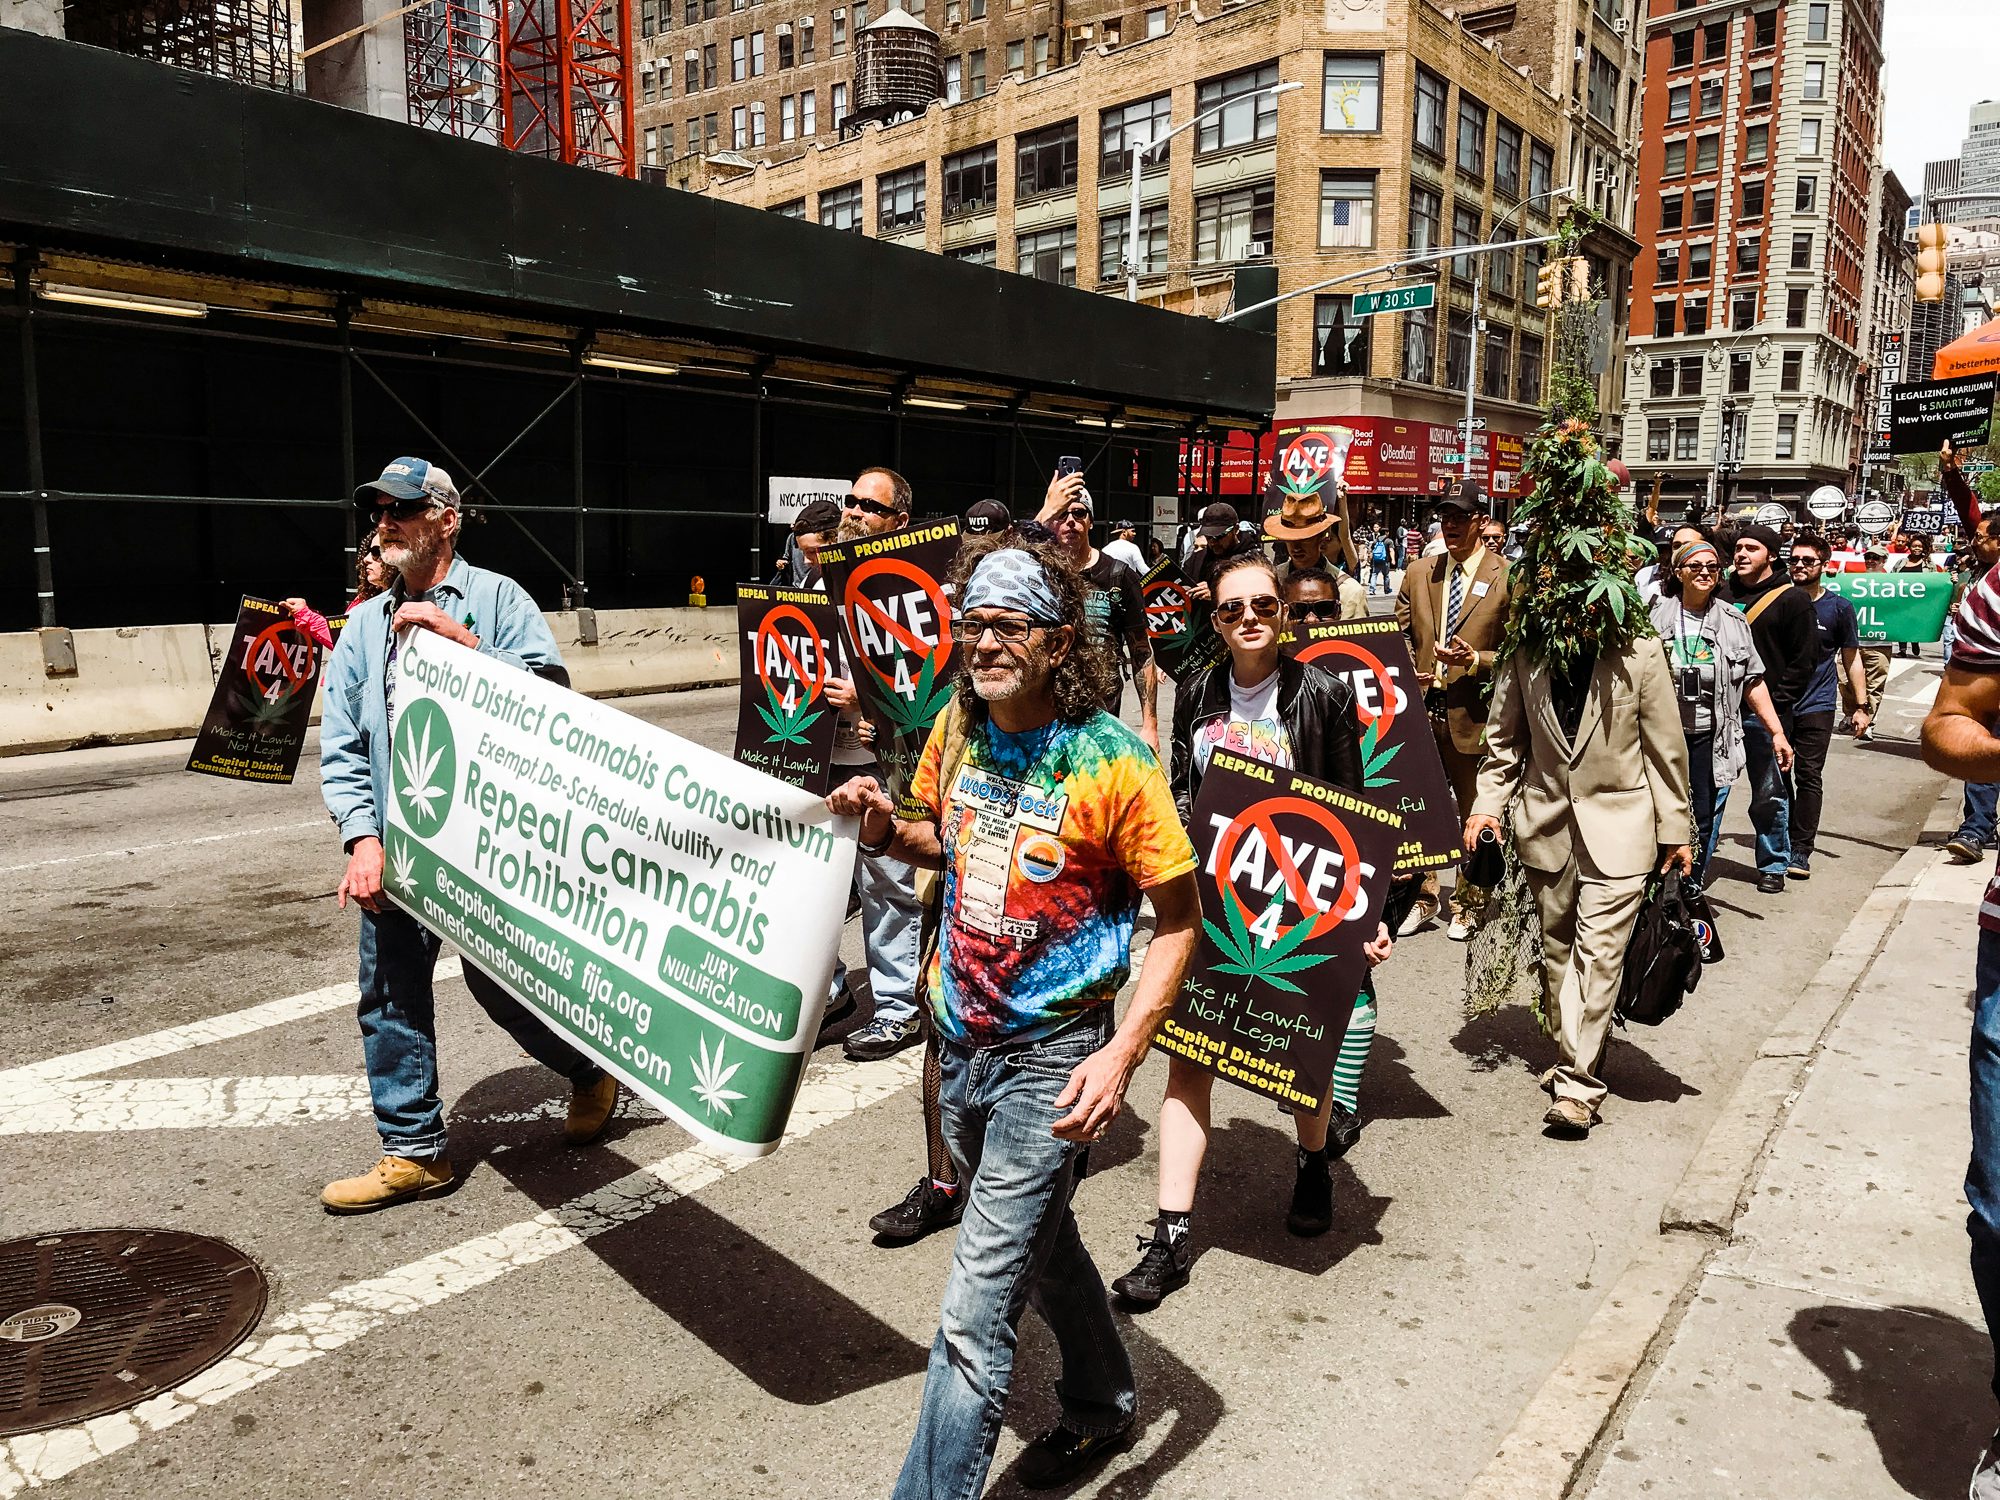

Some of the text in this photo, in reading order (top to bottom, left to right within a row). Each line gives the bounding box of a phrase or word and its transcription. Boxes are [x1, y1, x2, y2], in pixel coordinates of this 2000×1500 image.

[1370, 290, 1415, 310] W 30 St
[1885, 342, 1900, 350] NY
[1896, 381, 1993, 400] LEGALIZING MARIJUANA
[1929, 399, 1963, 411] SMART
[1964, 397, 1975, 406] for
[1898, 406, 1988, 424] New York Communities
[1354, 429, 1373, 438] Bead
[1952, 431, 1964, 439] start
[1267, 506, 1282, 515] Mak
[969, 516, 988, 526] wm
[1911, 514, 1941, 529] 338
[854, 523, 958, 558] PROHIBITION
[738, 588, 830, 605] REPEAL PROHIBITIO
[1852, 578, 1926, 598] State
[243, 599, 279, 615] REPEAL
[1146, 578, 1192, 632] AXE
[329, 618, 348, 629] REP
[837, 583, 963, 658] TAXES
[1172, 617, 1186, 634] 4
[1309, 622, 1399, 639] PROHIBITION
[241, 635, 318, 680] TAXES
[747, 631, 832, 684] TAXES
[1174, 655, 1195, 675] Make
[1200, 634, 1217, 648] Law
[1190, 656, 1205, 669] Not
[894, 659, 916, 701] 4
[264, 679, 279, 705] 4
[781, 684, 796, 718] 4
[211, 725, 298, 746] Make It Lawful
[228, 740, 282, 761] Not Legal
[403, 647, 834, 863] Capitol District Cannabis Consortium
[880, 749, 907, 764] Make
[191, 760, 292, 781] Cannabis Consortium
[211, 754, 283, 772] Capital District
[740, 749, 819, 774] Make It Lawful
[757, 766, 774, 776] Nt
[900, 768, 917, 782] No
[960, 774, 1059, 821] WOODSOCK
[1212, 752, 1402, 828] REPEAL PROHIBITION
[900, 794, 929, 808] Capit
[984, 803, 997, 811] NEW
[1397, 797, 1425, 813] ful
[895, 805, 927, 820] Cannabi
[978, 813, 991, 821] YOU
[992, 817, 1007, 826] MUST
[981, 821, 1009, 834] THIS HIGH
[988, 831, 1008, 840] ENTER!
[464, 760, 769, 955] Repeal Cannabis
[1397, 842, 1422, 855] rict
[730, 852, 776, 887] and
[1204, 813, 1376, 922] TAXES
[1393, 854, 1448, 870] ortium
[475, 825, 648, 962] Prohibition
[1005, 919, 1036, 928] POPULATION
[1008, 925, 1033, 936] 420
[1249, 902, 1279, 950] 4
[436, 866, 652, 1034] @capitolcannabis fija.org
[700, 951, 740, 985] JURY
[423, 896, 672, 1086] americansforcannabis.com
[663, 955, 783, 1032] NULLIFICATION
[1188, 998, 1291, 1052] Not Legal
[1224, 992, 1238, 1008] It
[1246, 999, 1324, 1040] Lawful
[1164, 1019, 1296, 1083] Capital District
[1154, 1033, 1318, 1109] nnabis Consortium
